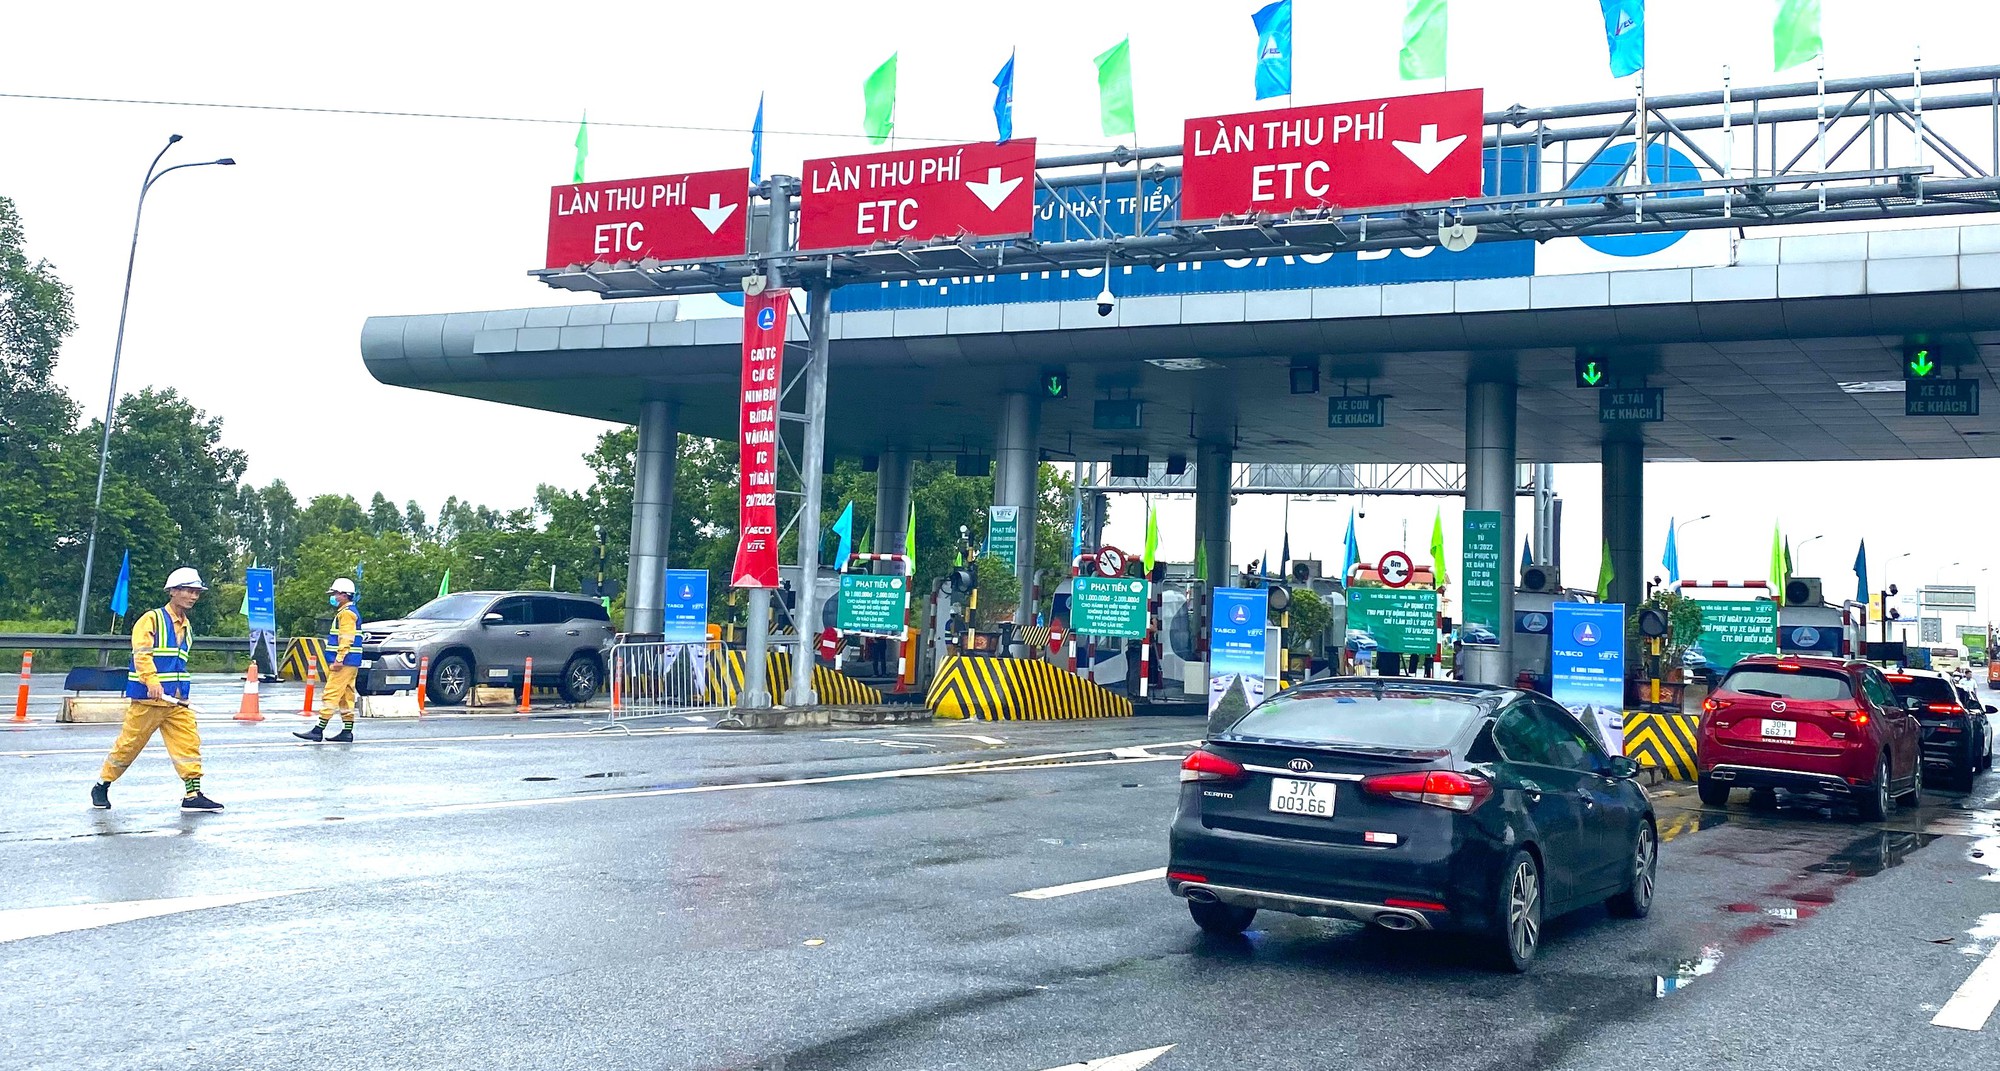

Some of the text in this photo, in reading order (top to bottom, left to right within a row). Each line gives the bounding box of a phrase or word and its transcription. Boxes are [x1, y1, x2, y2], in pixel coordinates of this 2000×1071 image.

[1194, 102, 1388, 157] LÀN THU PHÍ
[812, 148, 964, 194] LÀN THU PHÍ
[1252, 159, 1331, 202] ETC
[558, 176, 689, 216] LÀN THU PHÍ
[1059, 196, 1111, 219] PHÁT
[857, 198, 919, 234] ETC
[594, 221, 644, 254] ETC
[1921, 385, 1935, 396] XE
[1337, 400, 1369, 410] XE CON
[1612, 394, 1624, 404] XE
[1910, 399, 1967, 412] XE KHÁCH
[1331, 412, 1375, 424] XE KHÁCH
[1603, 406, 1653, 419] XE KHÁCH
[1390, 560, 1401, 568] 8m
[856, 580, 873, 589] PHẠT
[1090, 583, 1110, 593] PHẠT
[1292, 761, 1309, 770] KIA
[1290, 781, 1317, 797] 37K
[1278, 796, 1326, 813] 003.66
